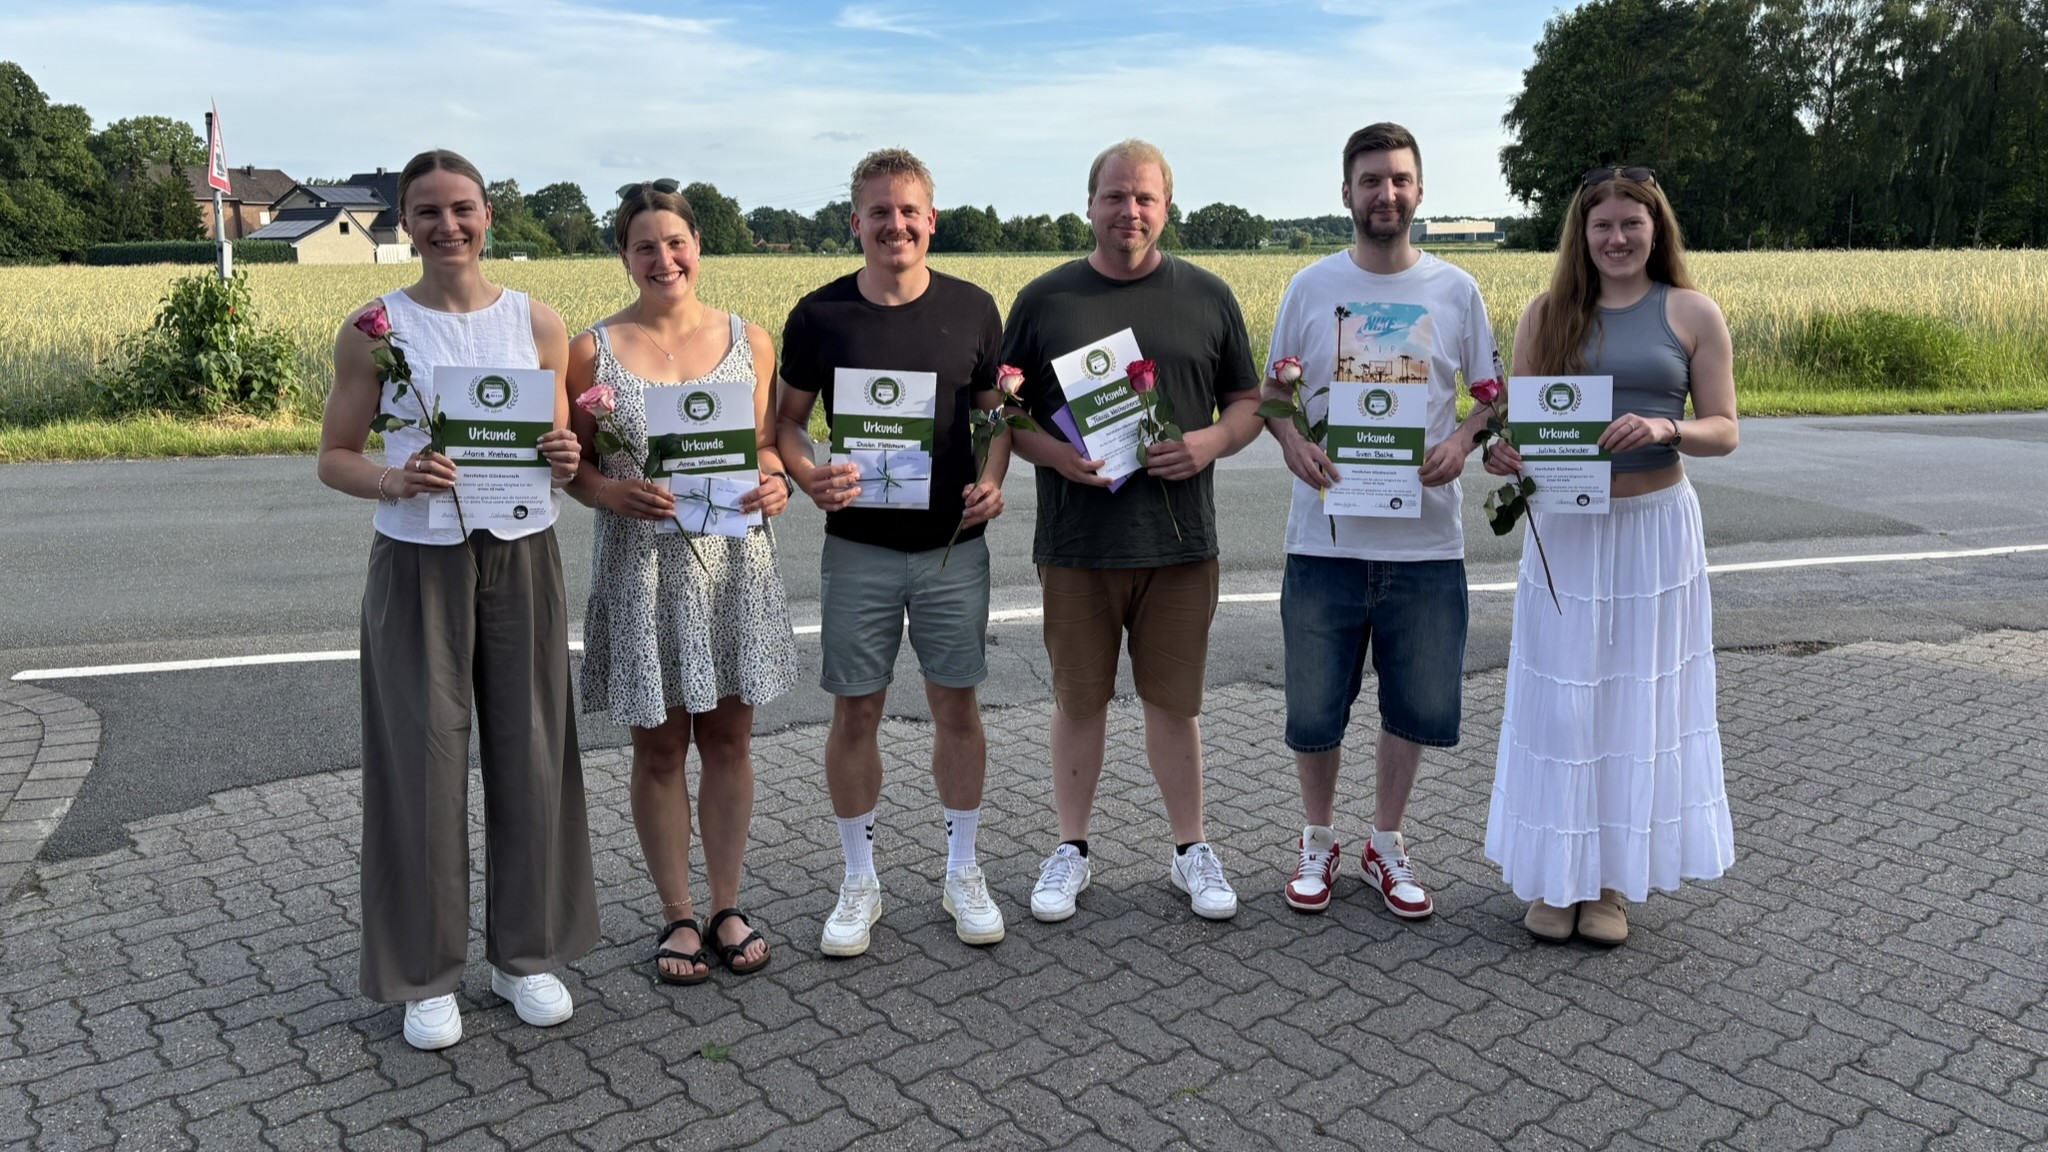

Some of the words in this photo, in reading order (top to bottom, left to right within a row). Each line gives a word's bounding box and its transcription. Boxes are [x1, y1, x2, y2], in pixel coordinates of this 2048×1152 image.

[1362, 316, 1397, 331] NIKE
[1093, 385, 1128, 406] Urkunde
[468, 427, 517, 441] Urkunde
[863, 421, 903, 434] Urkunde
[1539, 427, 1580, 439] Urkunde
[1356, 431, 1396, 444] Urkunde
[681, 438, 724, 452] Urkunde
[1558, 446, 1589, 454] Schneider
[462, 449, 485, 458] Marie
[1355, 450, 1372, 458] Sven
